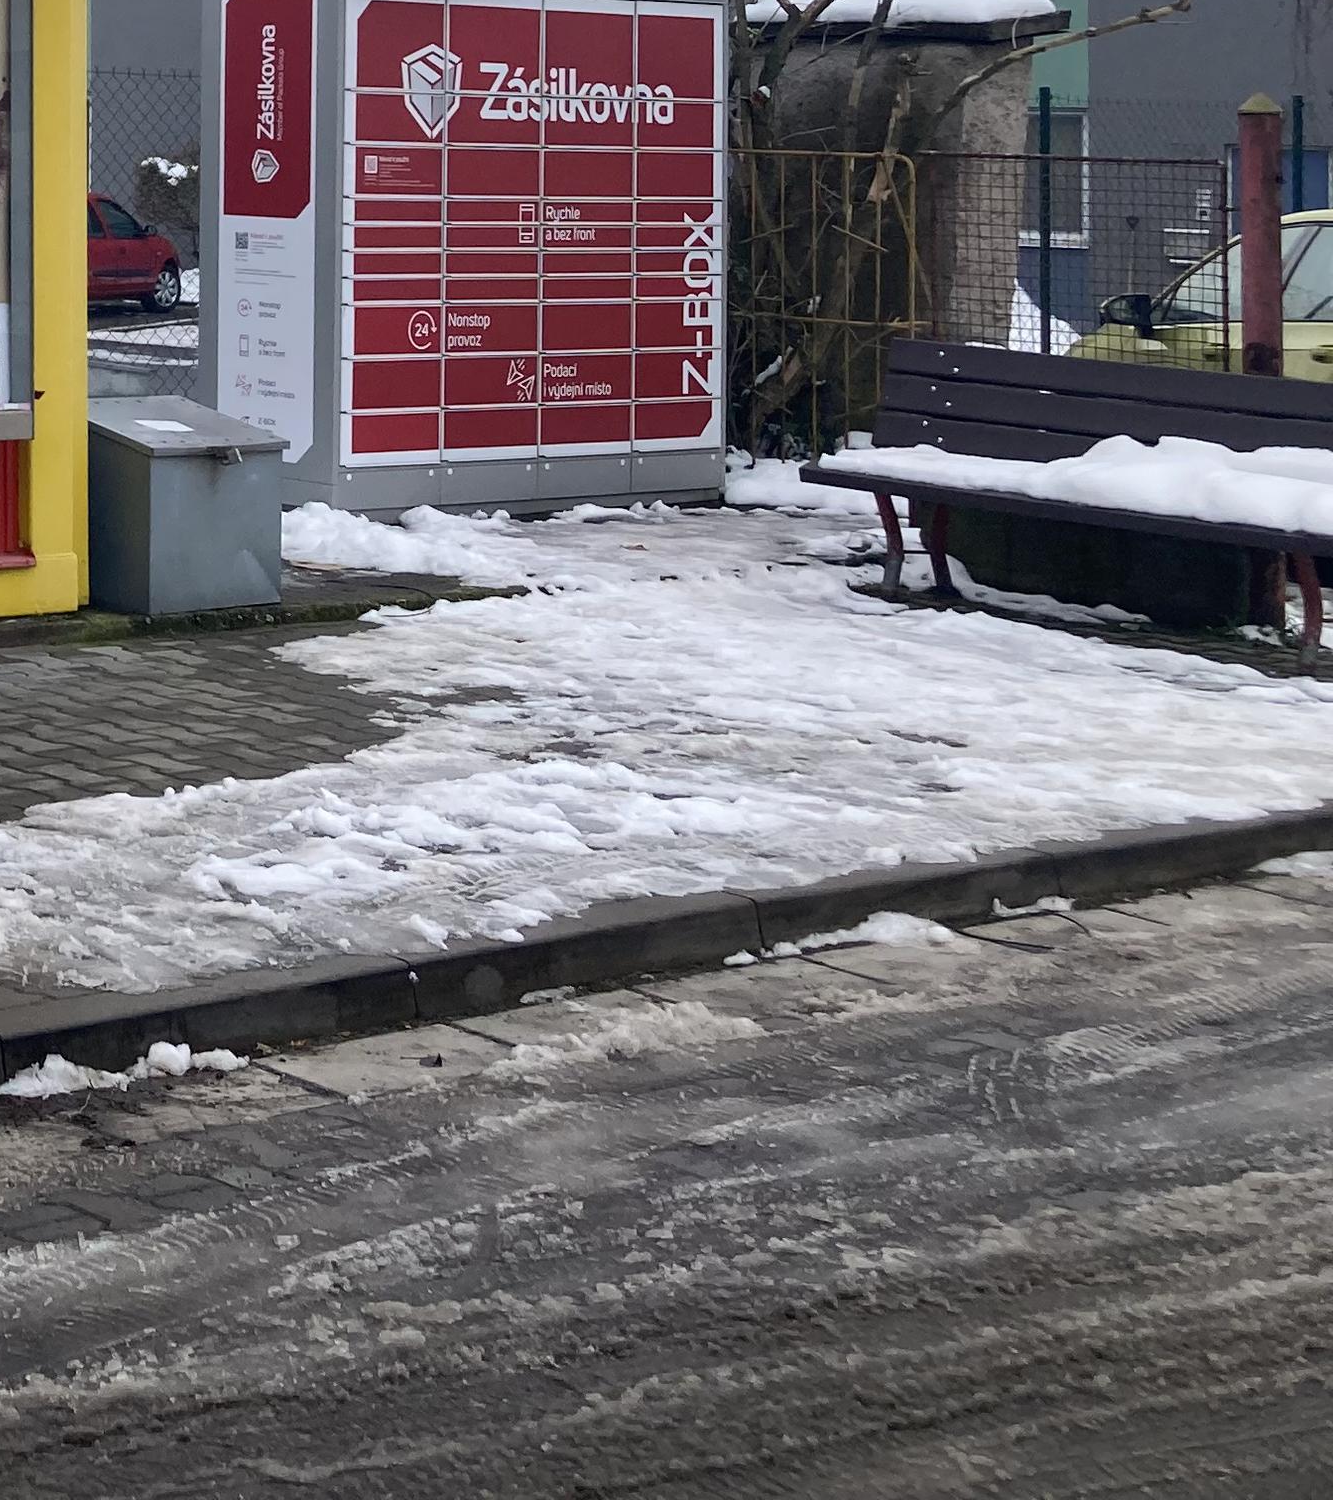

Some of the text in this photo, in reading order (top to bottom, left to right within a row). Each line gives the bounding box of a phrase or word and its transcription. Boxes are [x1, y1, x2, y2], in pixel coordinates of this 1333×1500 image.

[257, 24, 276, 140] Zásilkovna
[480, 62, 674, 125] Zásilkovna
[546, 205, 581, 221] Rychle
[545, 228, 596, 241] a bez front
[683, 211, 714, 395] Z-BOX
[448, 312, 491, 330] Nonstop
[415, 323, 429, 338] 24
[448, 334, 482, 348] provoz
[544, 362, 577, 377] Podací
[547, 383, 584, 399] výdejní
[585, 382, 612, 396] místo
